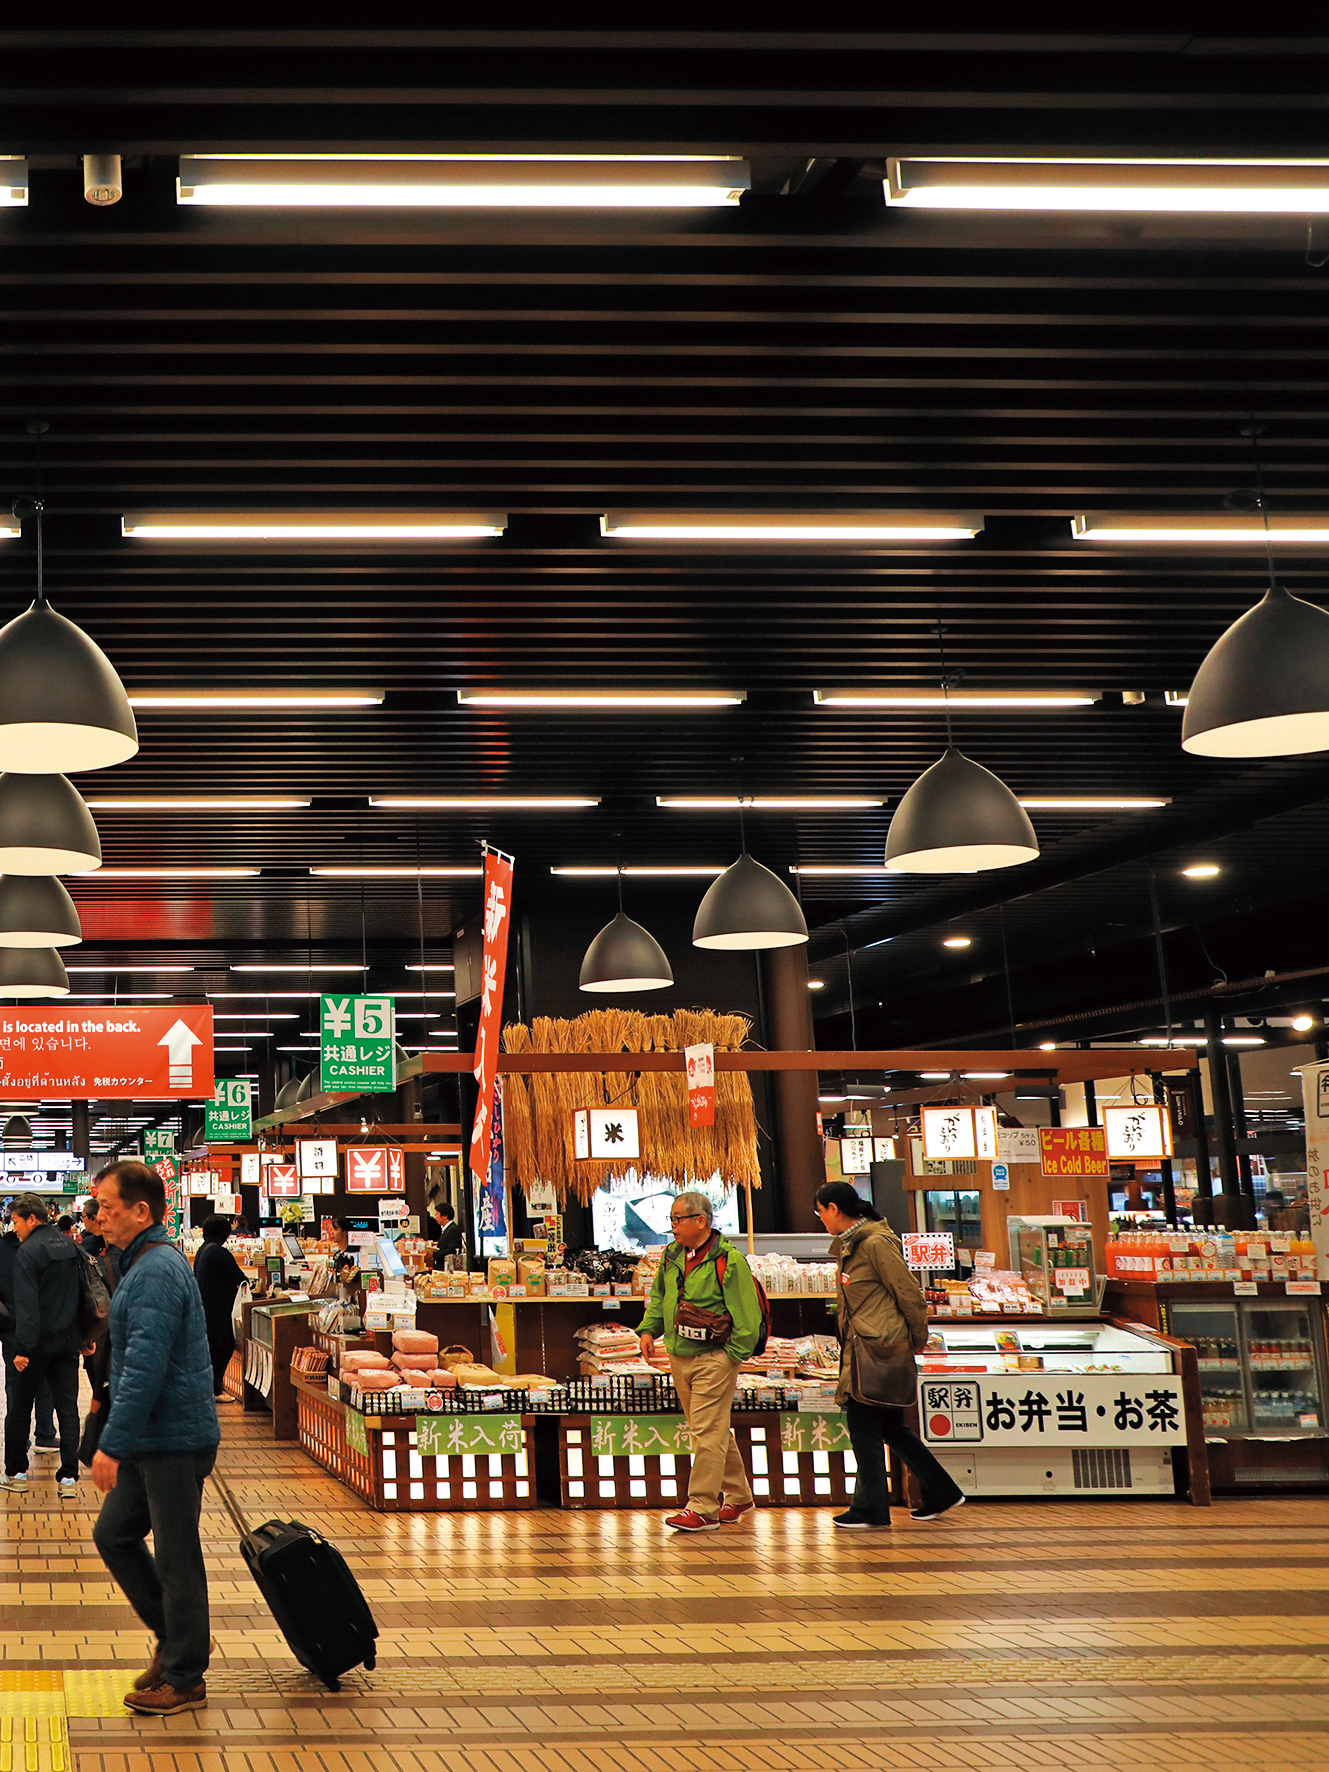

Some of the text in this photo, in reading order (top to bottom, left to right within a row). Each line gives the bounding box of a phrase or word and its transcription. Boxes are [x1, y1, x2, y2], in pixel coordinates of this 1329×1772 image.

[2, 1021, 13, 1033] is
[16, 1021, 63, 1033] located
[66, 1021, 78, 1033] in
[81, 1021, 103, 1033] the
[106, 1020, 141, 1033] back.
[32, 1037, 91, 1051] 있습니다.
[324, 1045, 390, 1062] 共通レジ
[330, 1065, 385, 1075] CASHIER
[93, 1077, 153, 1087] 免税カウンター
[209, 1110, 250, 1121] 共通レジ
[605, 1122, 624, 1143] 米
[1041, 1131, 1105, 1152] ビール各種
[353, 1151, 381, 1188] ¥
[389, 1152, 401, 1188] ¥
[1044, 1155, 1107, 1174] Ice Cold Beer
[273, 1167, 295, 1194] ¥
[910, 1242, 950, 1265] 駅弁
[927, 1387, 973, 1409] 駅弁
[986, 1389, 1180, 1433] お弁当・お茶
[418, 1418, 521, 1454] 新米入荷
[592, 1419, 693, 1455] 新米入荷
